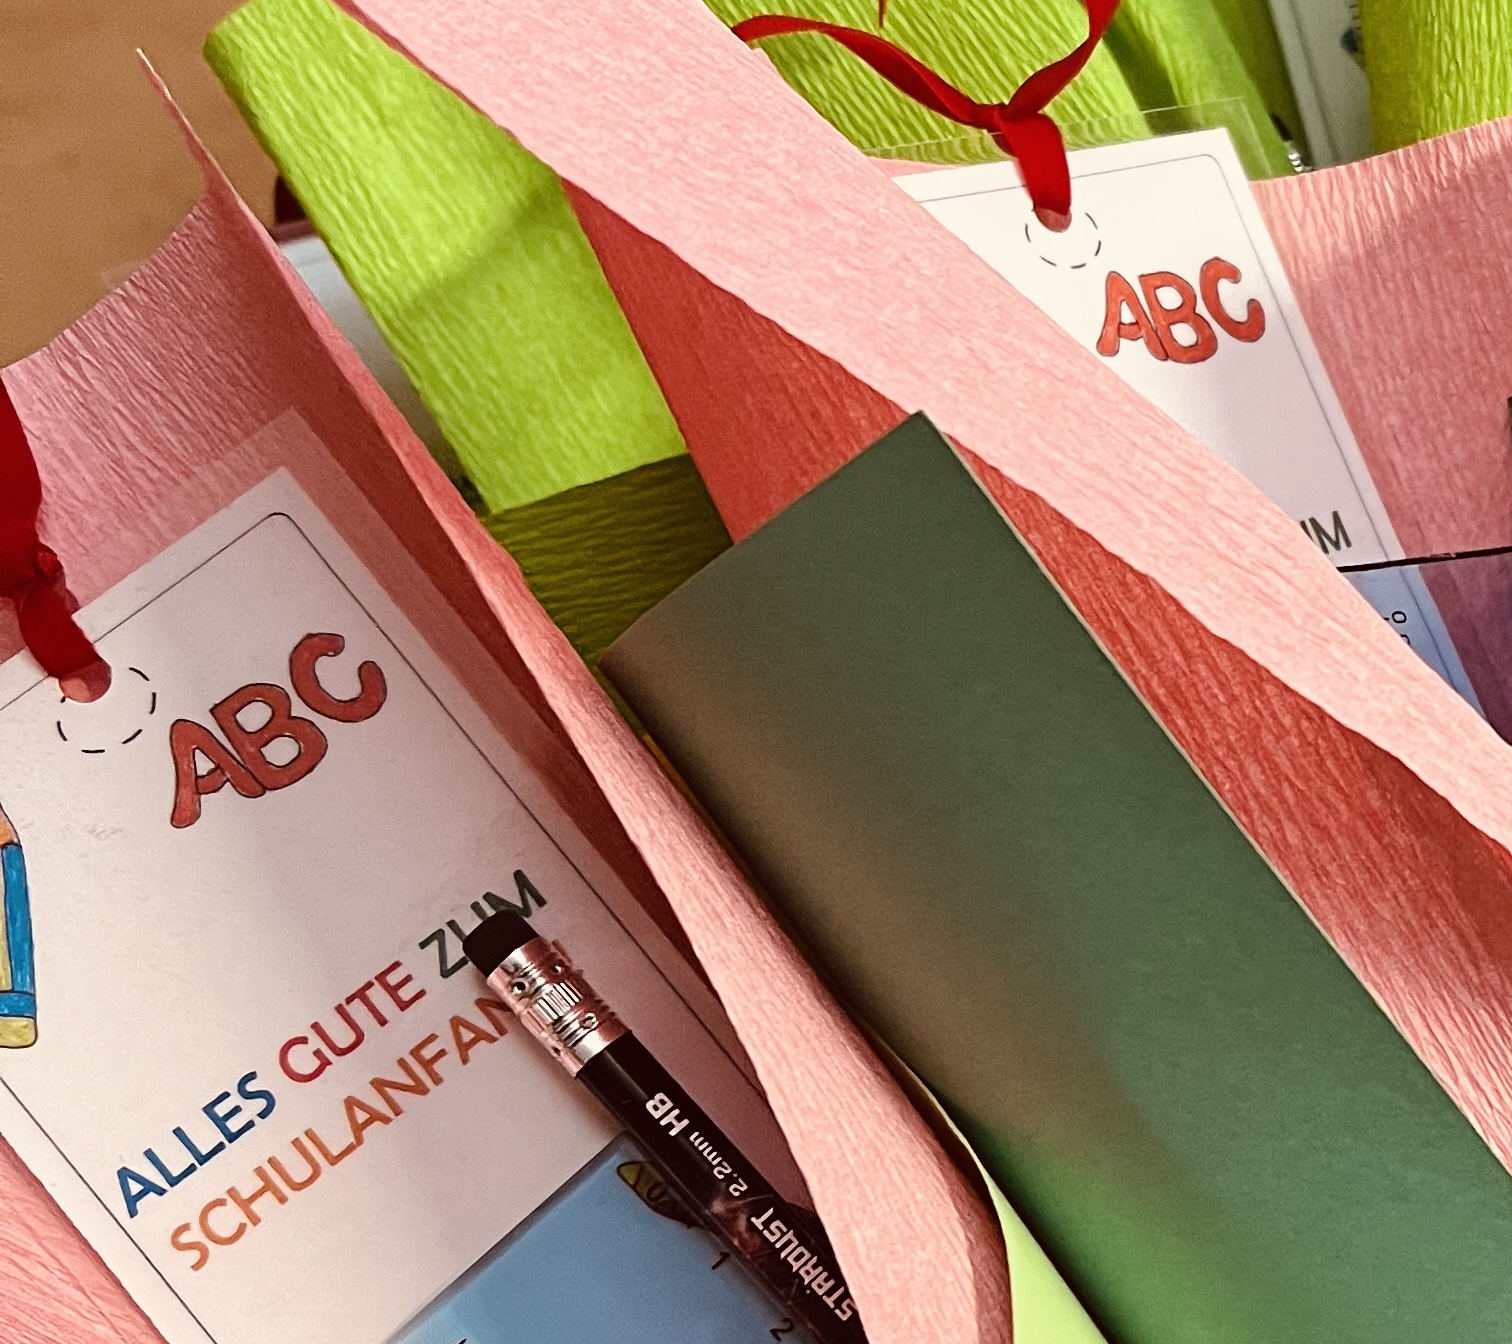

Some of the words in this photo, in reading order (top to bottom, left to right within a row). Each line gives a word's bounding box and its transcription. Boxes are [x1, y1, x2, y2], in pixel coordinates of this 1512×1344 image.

[1097, 256, 1265, 364] ABC
[170, 632, 388, 829] ABC
[114, 1070, 277, 1219] ALLES
[278, 960, 428, 1086] GUTE
[645, 1092, 690, 1137] HB
[689, 1131, 749, 1197] 2.2mm
[750, 1207, 853, 1322] STARDUST
